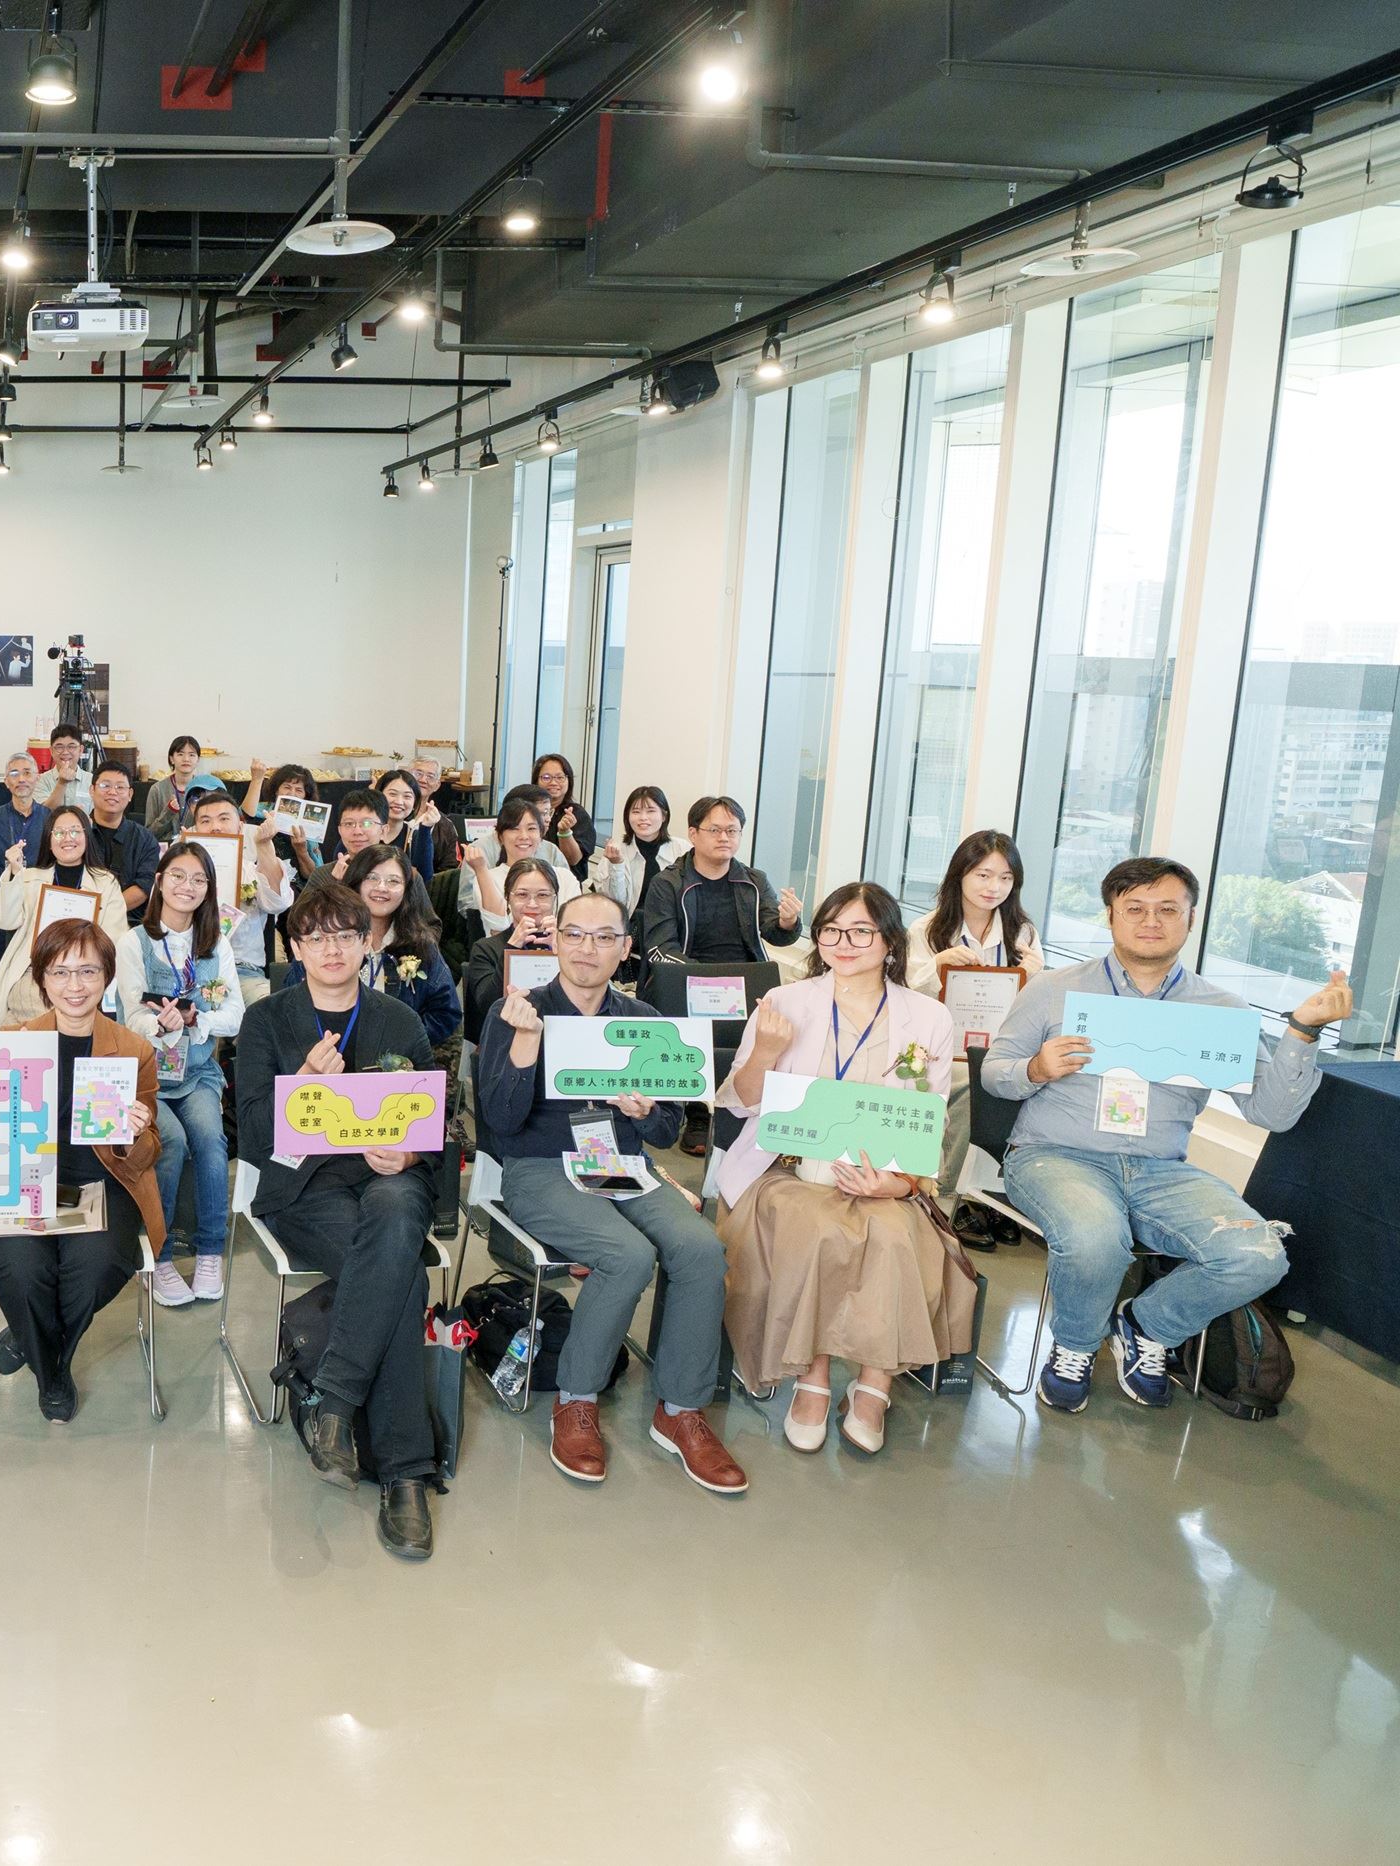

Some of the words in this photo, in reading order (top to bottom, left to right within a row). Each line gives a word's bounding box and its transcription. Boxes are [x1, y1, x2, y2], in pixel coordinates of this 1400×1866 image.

[615, 1029, 651, 1039] 鍾肇政
[660, 1053, 696, 1063] 魯冰花
[1200, 1050, 1242, 1063] 巨流河
[300, 1091, 323, 1101] 噤聲
[306, 1105, 316, 1114] 的
[855, 1099, 936, 1121] 美國現代主義
[299, 1118, 322, 1127] 密室
[881, 1117, 934, 1134] 文學特展
[339, 1128, 400, 1138] 白恐文學讀
[767, 1122, 818, 1139] 群星閃耀
